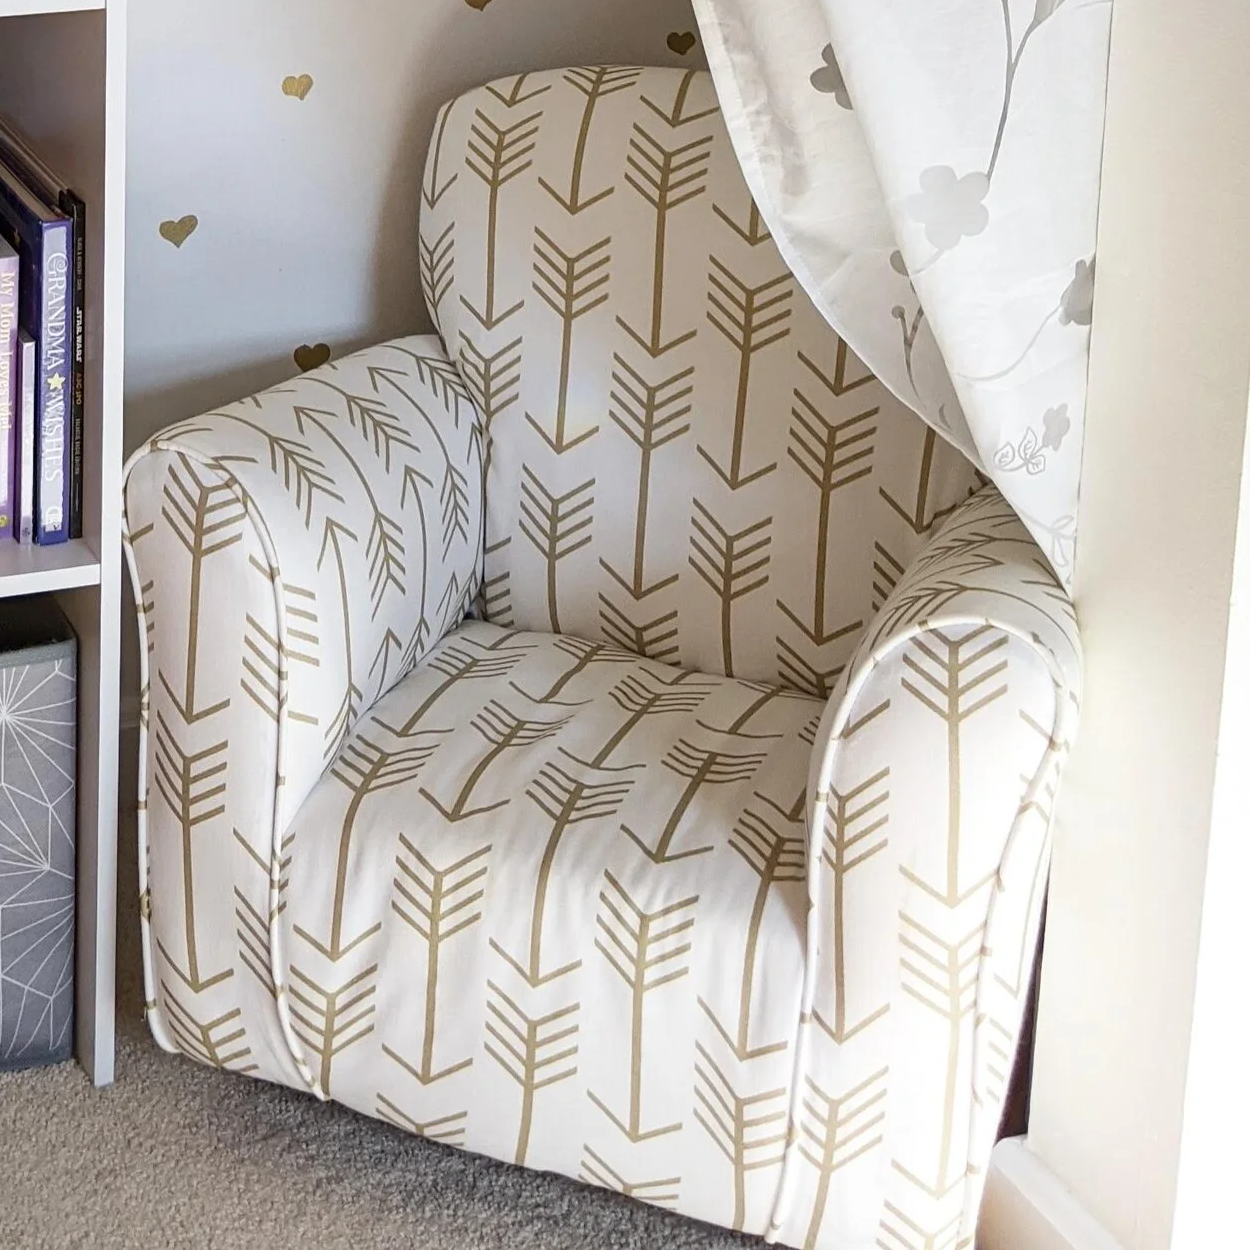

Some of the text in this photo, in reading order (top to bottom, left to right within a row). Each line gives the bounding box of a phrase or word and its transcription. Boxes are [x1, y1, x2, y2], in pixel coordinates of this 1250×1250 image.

[0, 271, 16, 297] My
[46, 252, 68, 371] GRANDMA
[0, 302, 15, 344] Mom
[43, 391, 66, 482] WISHES
